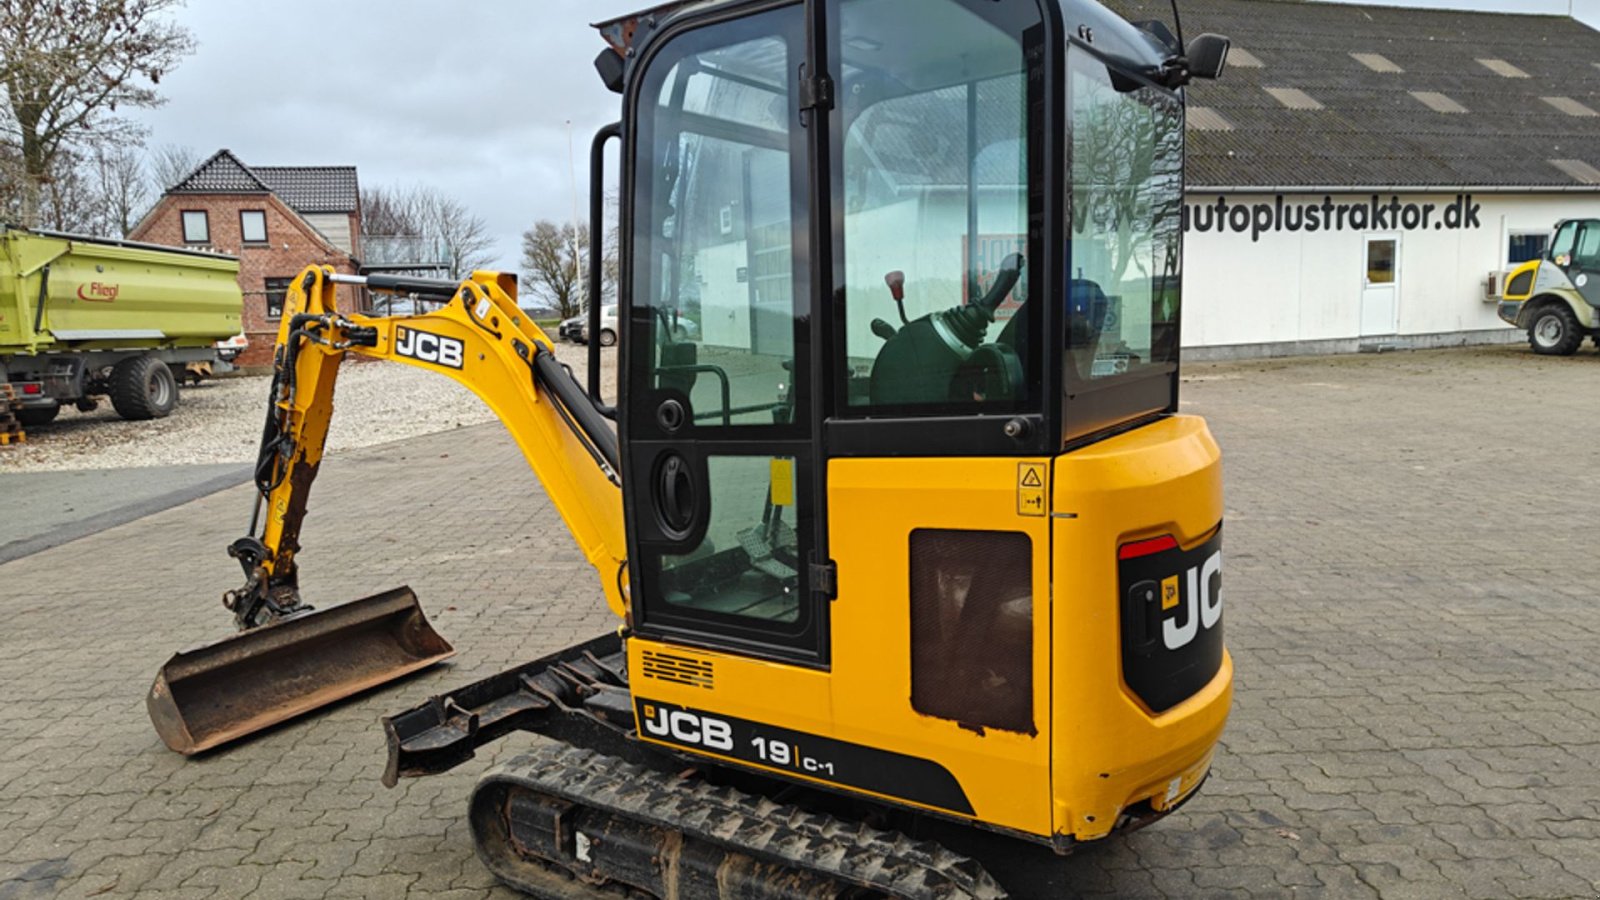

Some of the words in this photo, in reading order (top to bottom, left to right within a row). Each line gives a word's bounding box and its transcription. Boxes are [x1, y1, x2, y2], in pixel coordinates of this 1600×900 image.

[397, 329, 463, 367] JCB
[645, 708, 733, 751] JCB
[751, 737, 791, 765] 19
